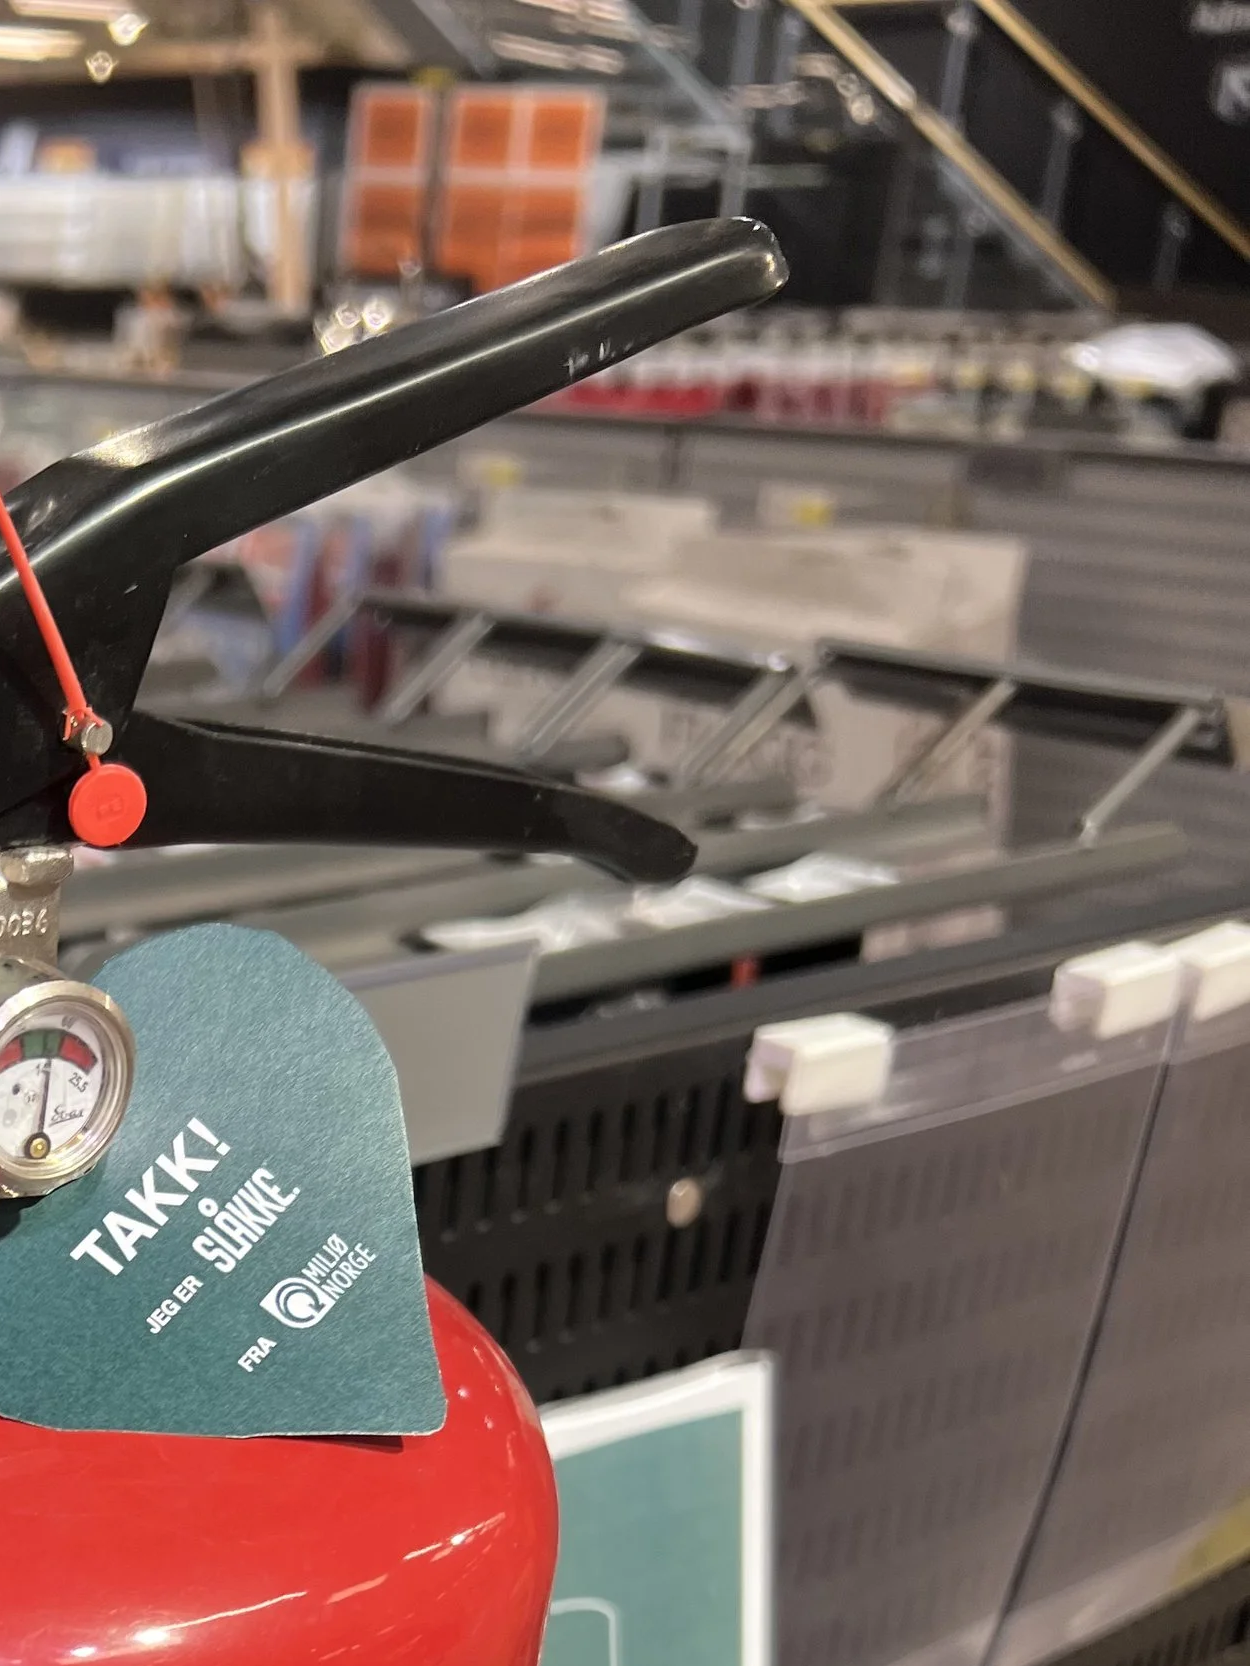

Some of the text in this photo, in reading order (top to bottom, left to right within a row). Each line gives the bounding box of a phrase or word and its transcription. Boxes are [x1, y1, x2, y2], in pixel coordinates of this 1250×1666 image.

[69, 1117, 231, 1276] TAKK!
[146, 1298, 181, 1335] JEG
[173, 1274, 204, 1304] ER
[237, 1233, 349, 1373] FRA MILJØ
[321, 1242, 378, 1300] NORGE
